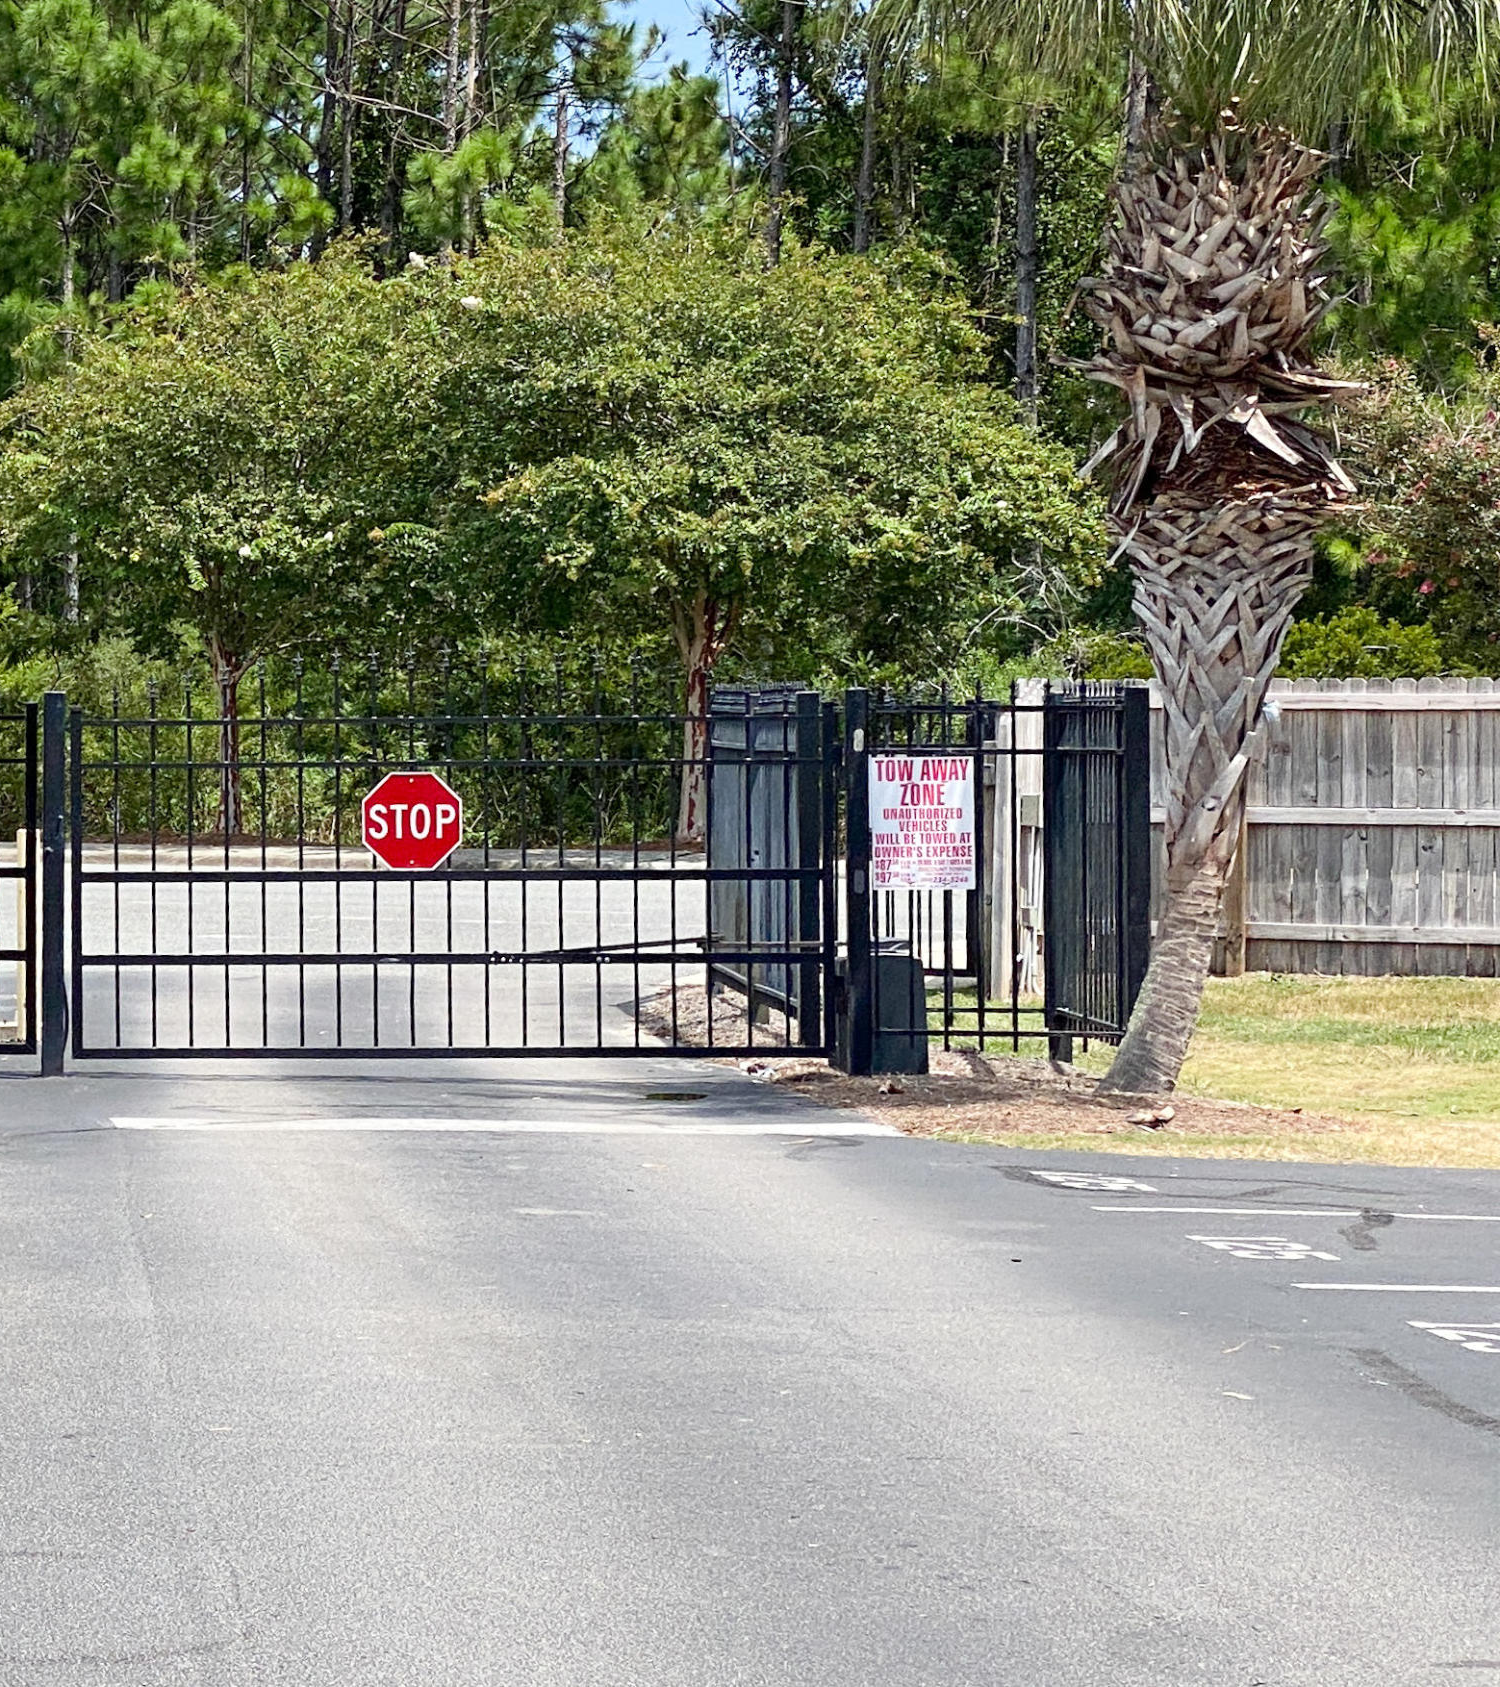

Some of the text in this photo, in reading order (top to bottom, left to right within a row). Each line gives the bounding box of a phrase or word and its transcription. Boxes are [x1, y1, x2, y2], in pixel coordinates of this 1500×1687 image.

[875, 758, 969, 781] TOW AWAY
[900, 783, 945, 806] ZONE
[883, 808, 963, 820] UNAUTHORIZED
[368, 803, 456, 840] STOP
[899, 820, 948, 832] VEHICLES
[875, 832, 971, 845] WILL BE TOWED AT
[874, 846, 973, 858] OWNER'S EXPENSE
